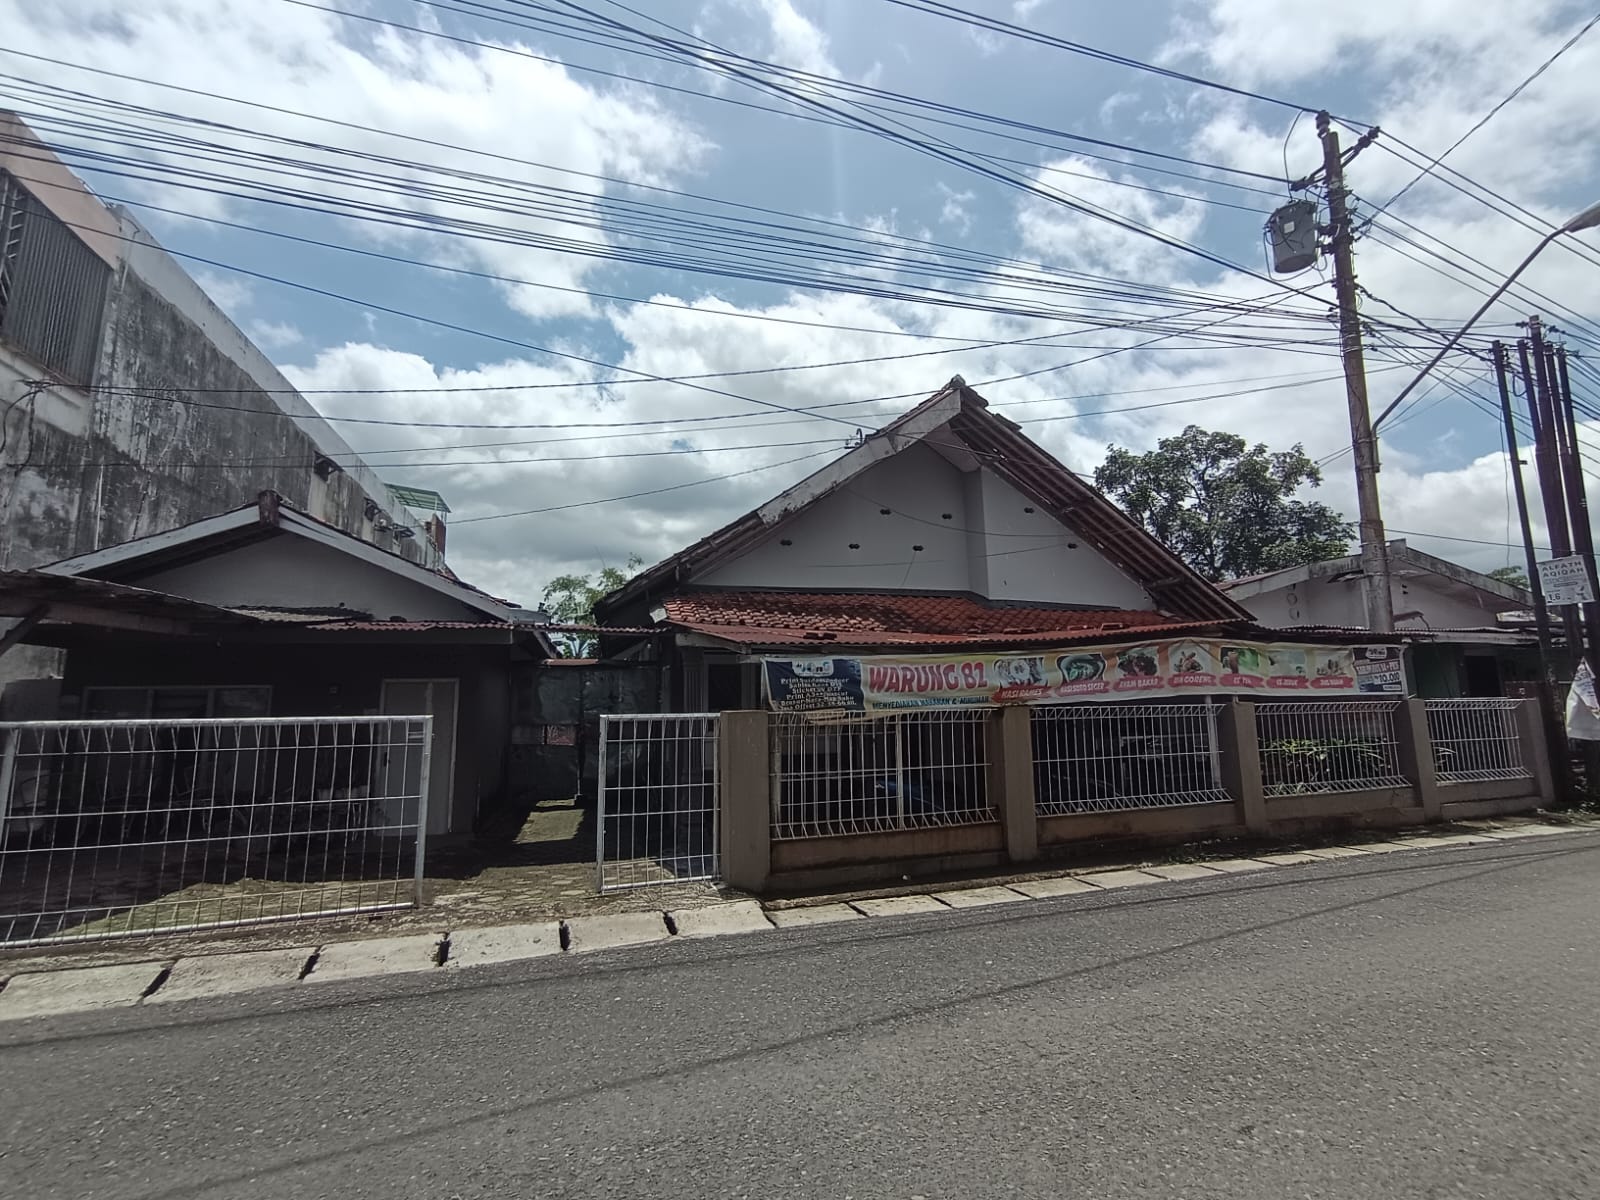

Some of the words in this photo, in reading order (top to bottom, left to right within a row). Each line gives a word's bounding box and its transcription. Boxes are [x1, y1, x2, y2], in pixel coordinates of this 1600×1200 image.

[1542, 561, 1581, 571] ALFATH
[1543, 568, 1584, 577] AQIQAH
[869, 664, 959, 693] WARUNG
[1001, 690, 1020, 699] NASI
